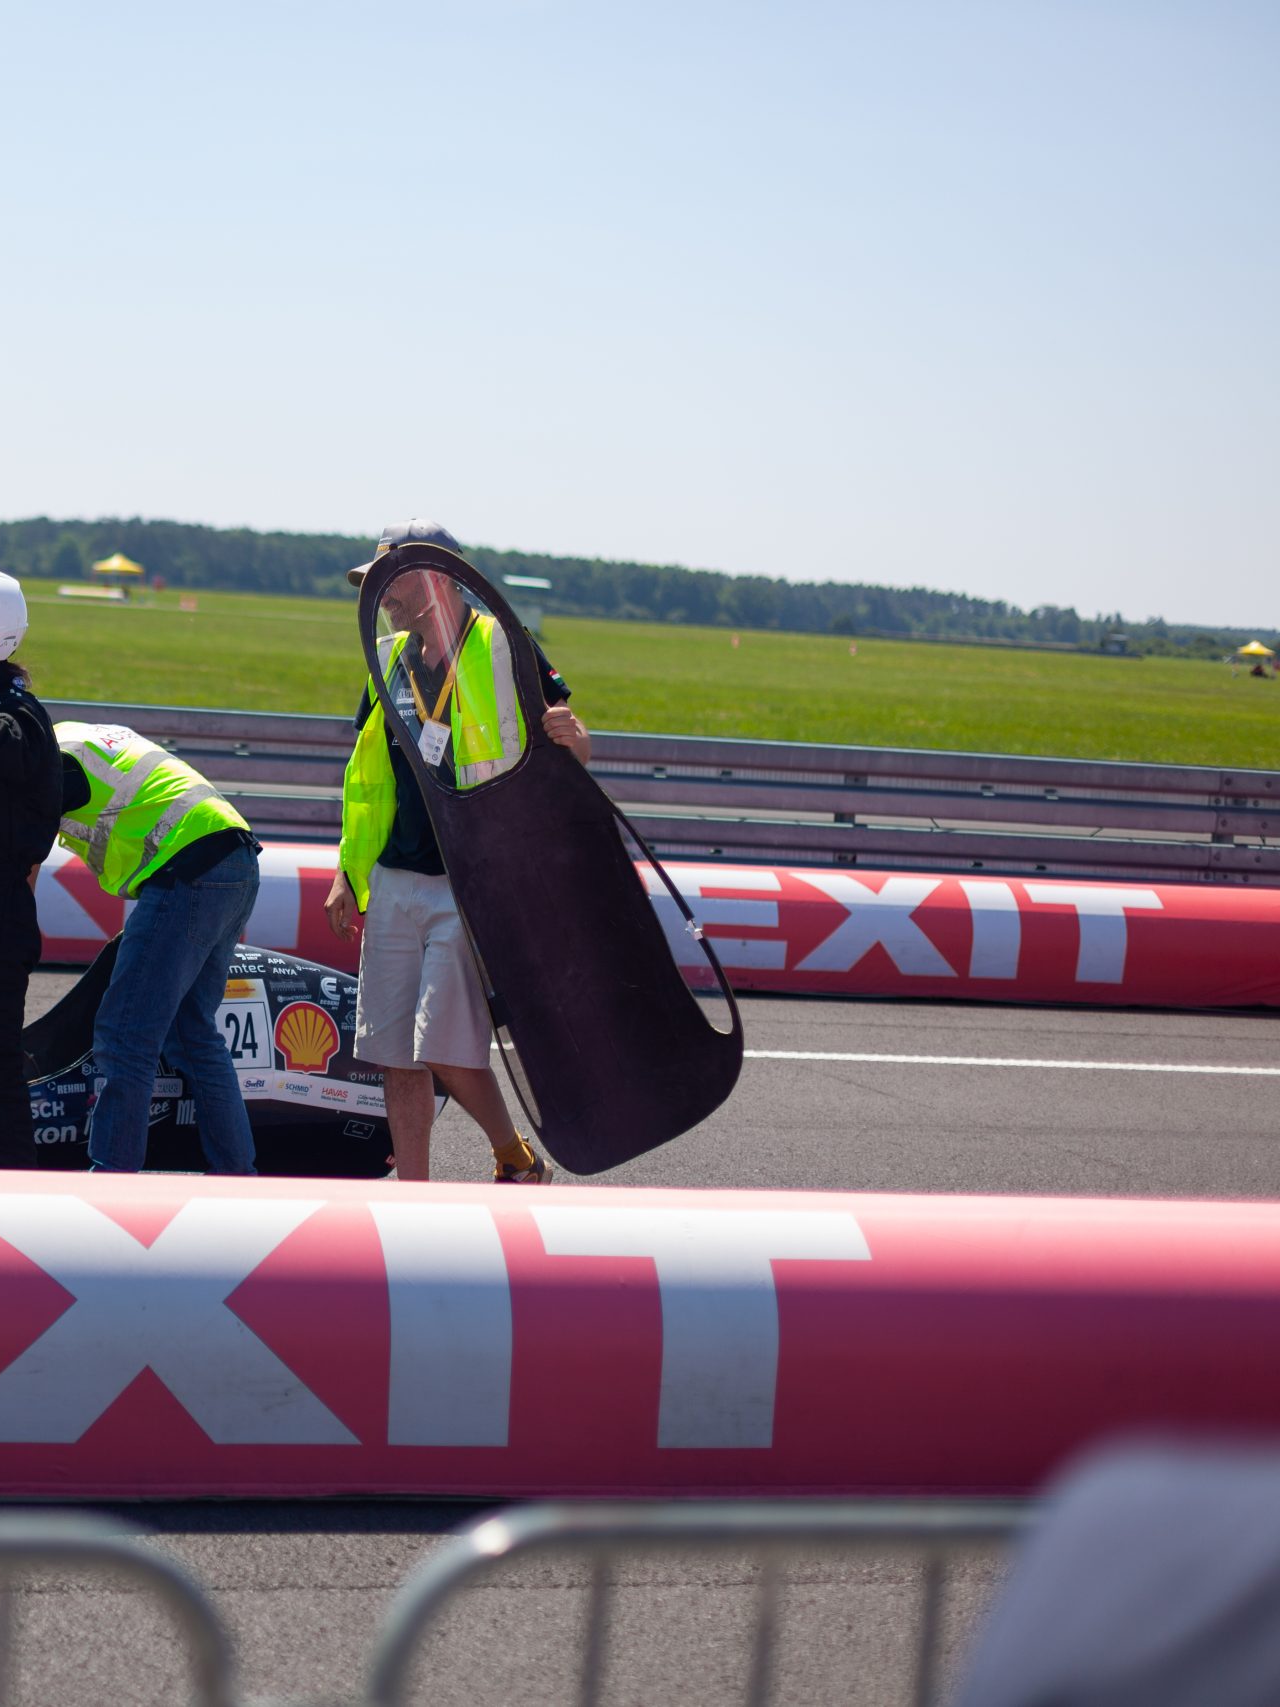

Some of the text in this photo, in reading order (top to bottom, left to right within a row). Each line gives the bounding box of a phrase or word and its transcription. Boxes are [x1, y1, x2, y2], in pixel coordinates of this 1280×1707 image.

[398, 708, 419, 717] axon
[637, 865, 1163, 985] EXIT
[229, 963, 266, 974] mtec
[272, 967, 298, 976] ANYA
[225, 1012, 259, 1059] 24
[350, 1072, 384, 1082] OMIKR
[57, 1082, 86, 1095] REHAU
[285, 1083, 310, 1093] SCHMID
[321, 1087, 349, 1099] HAVAS
[30, 1100, 65, 1119] SCH
[33, 1125, 77, 1144] xon
